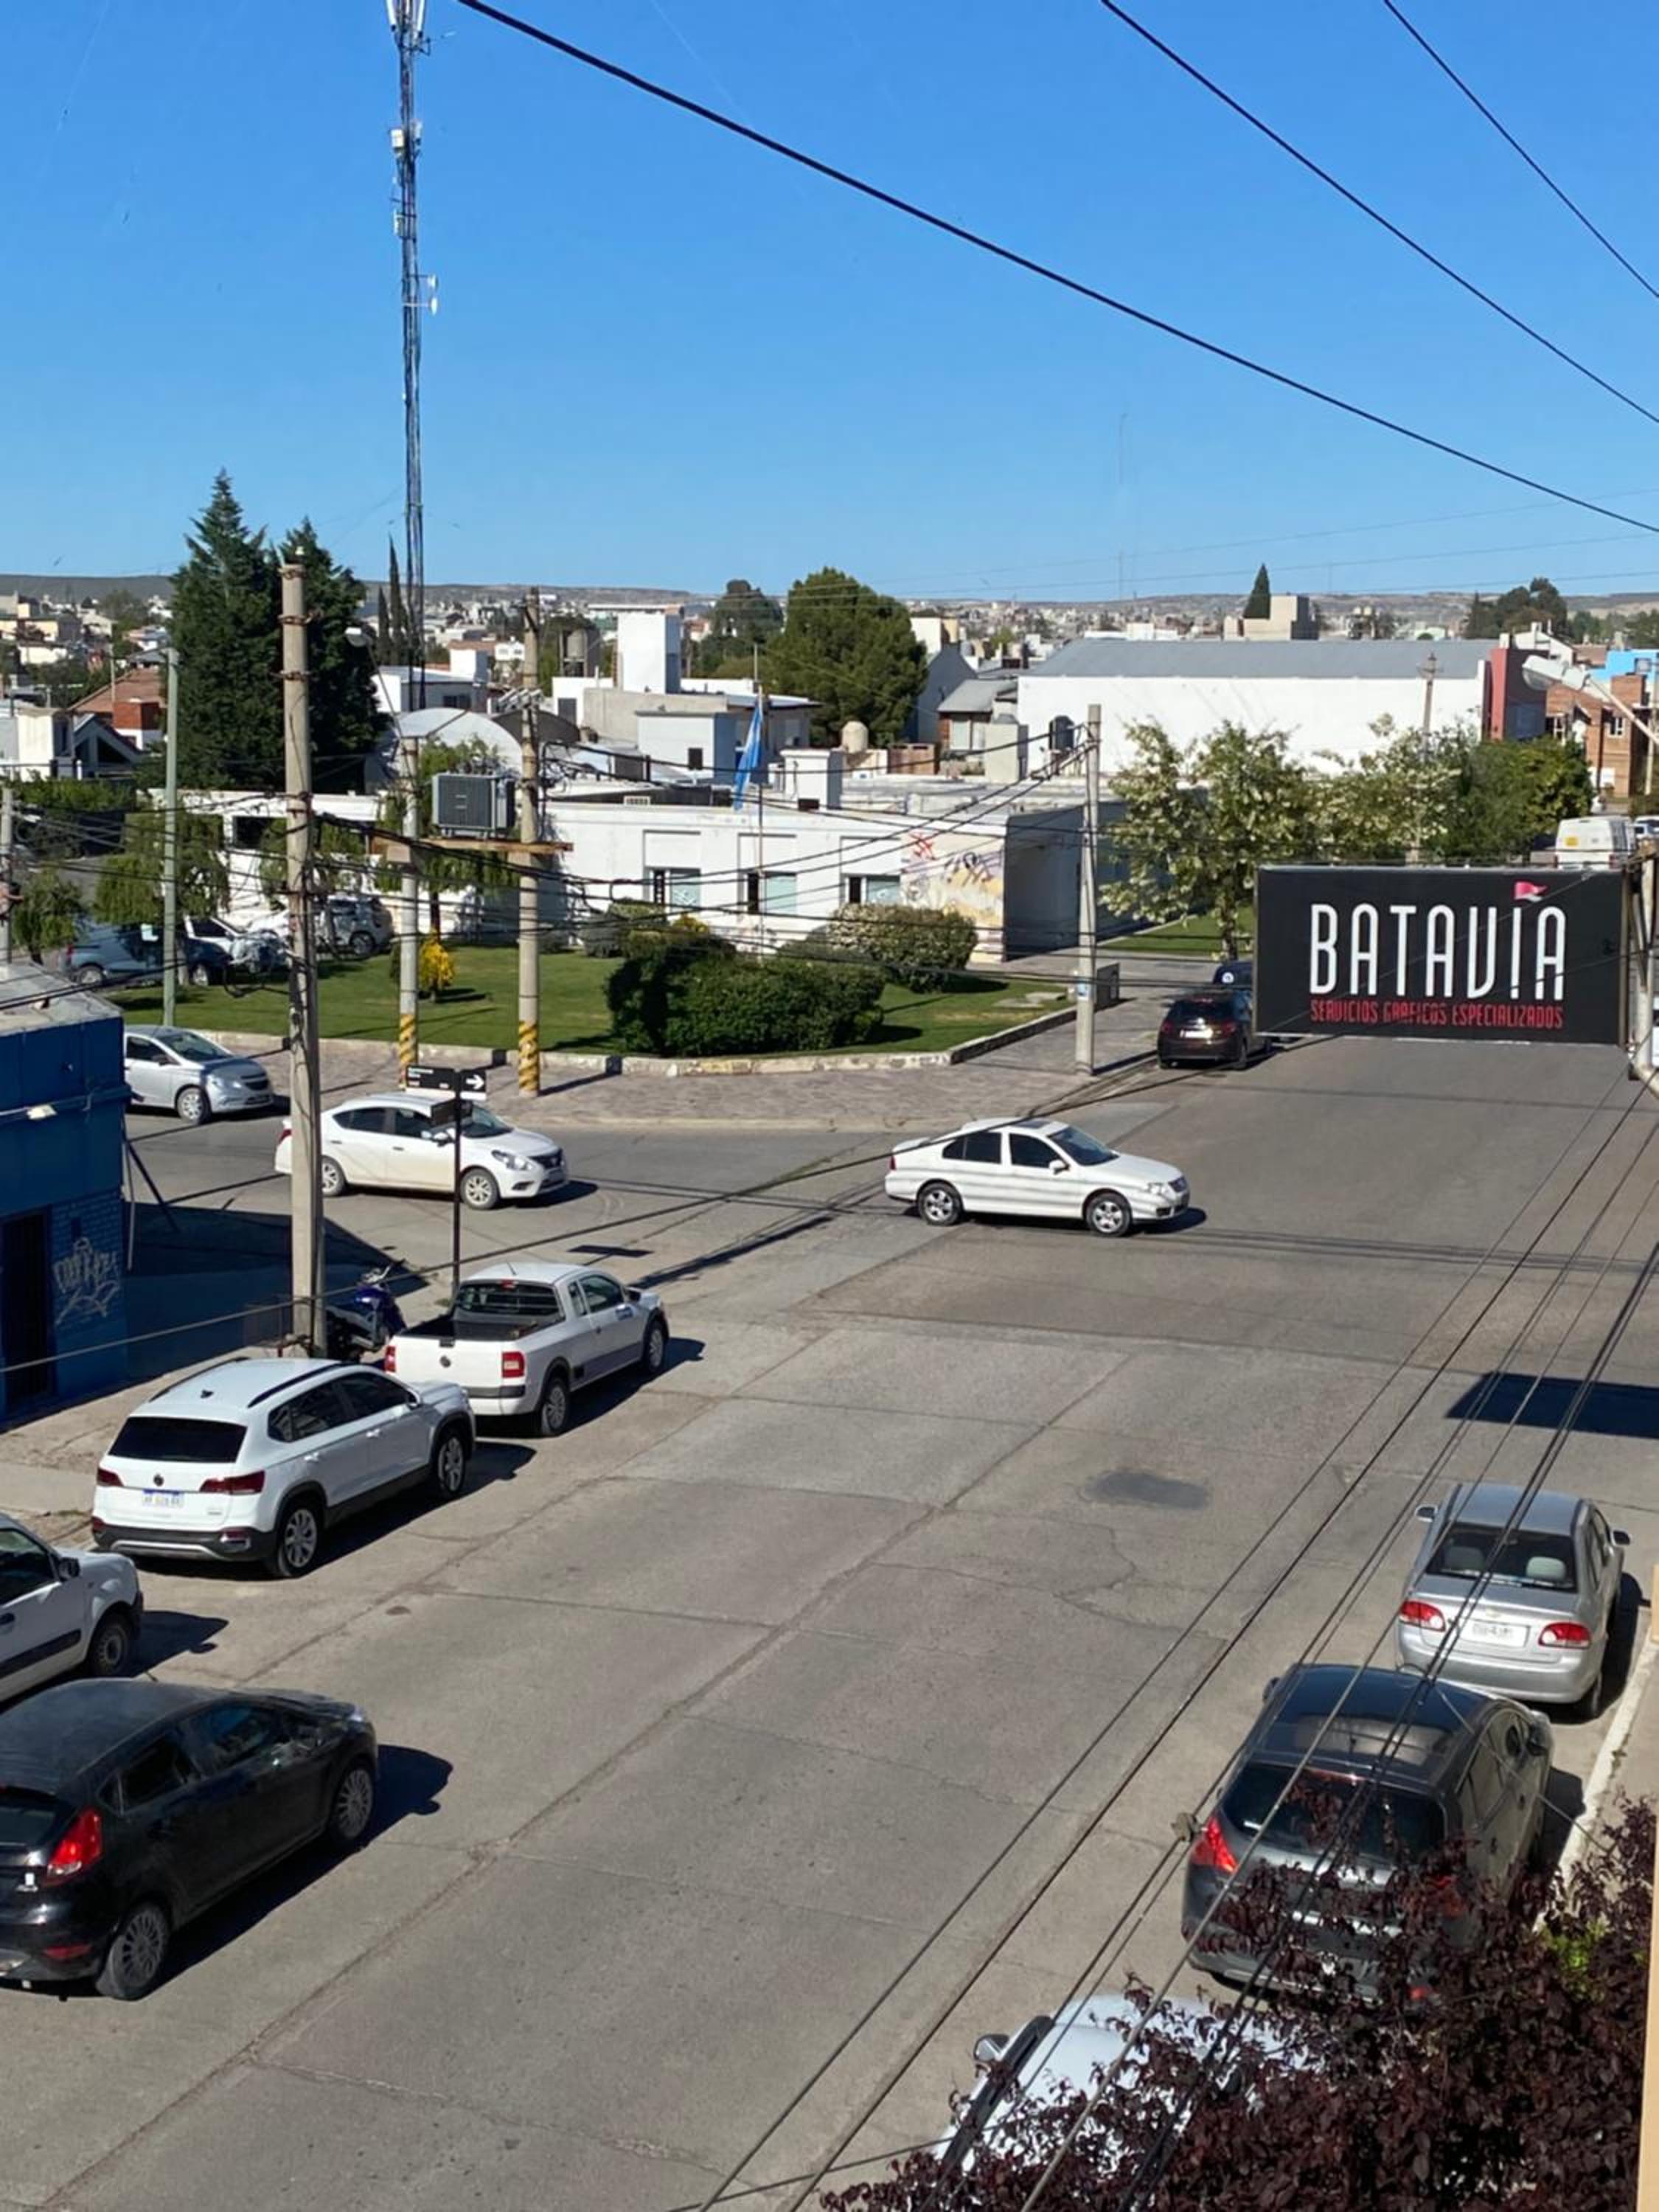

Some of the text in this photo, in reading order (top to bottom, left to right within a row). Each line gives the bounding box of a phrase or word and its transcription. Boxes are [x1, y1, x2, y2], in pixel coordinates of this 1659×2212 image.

[1310, 903, 1567, 1001] BATAVIA
[1310, 999, 1378, 1023] SERVICIOS
[1452, 1004, 1564, 1029] ESPECIALIZADOS
